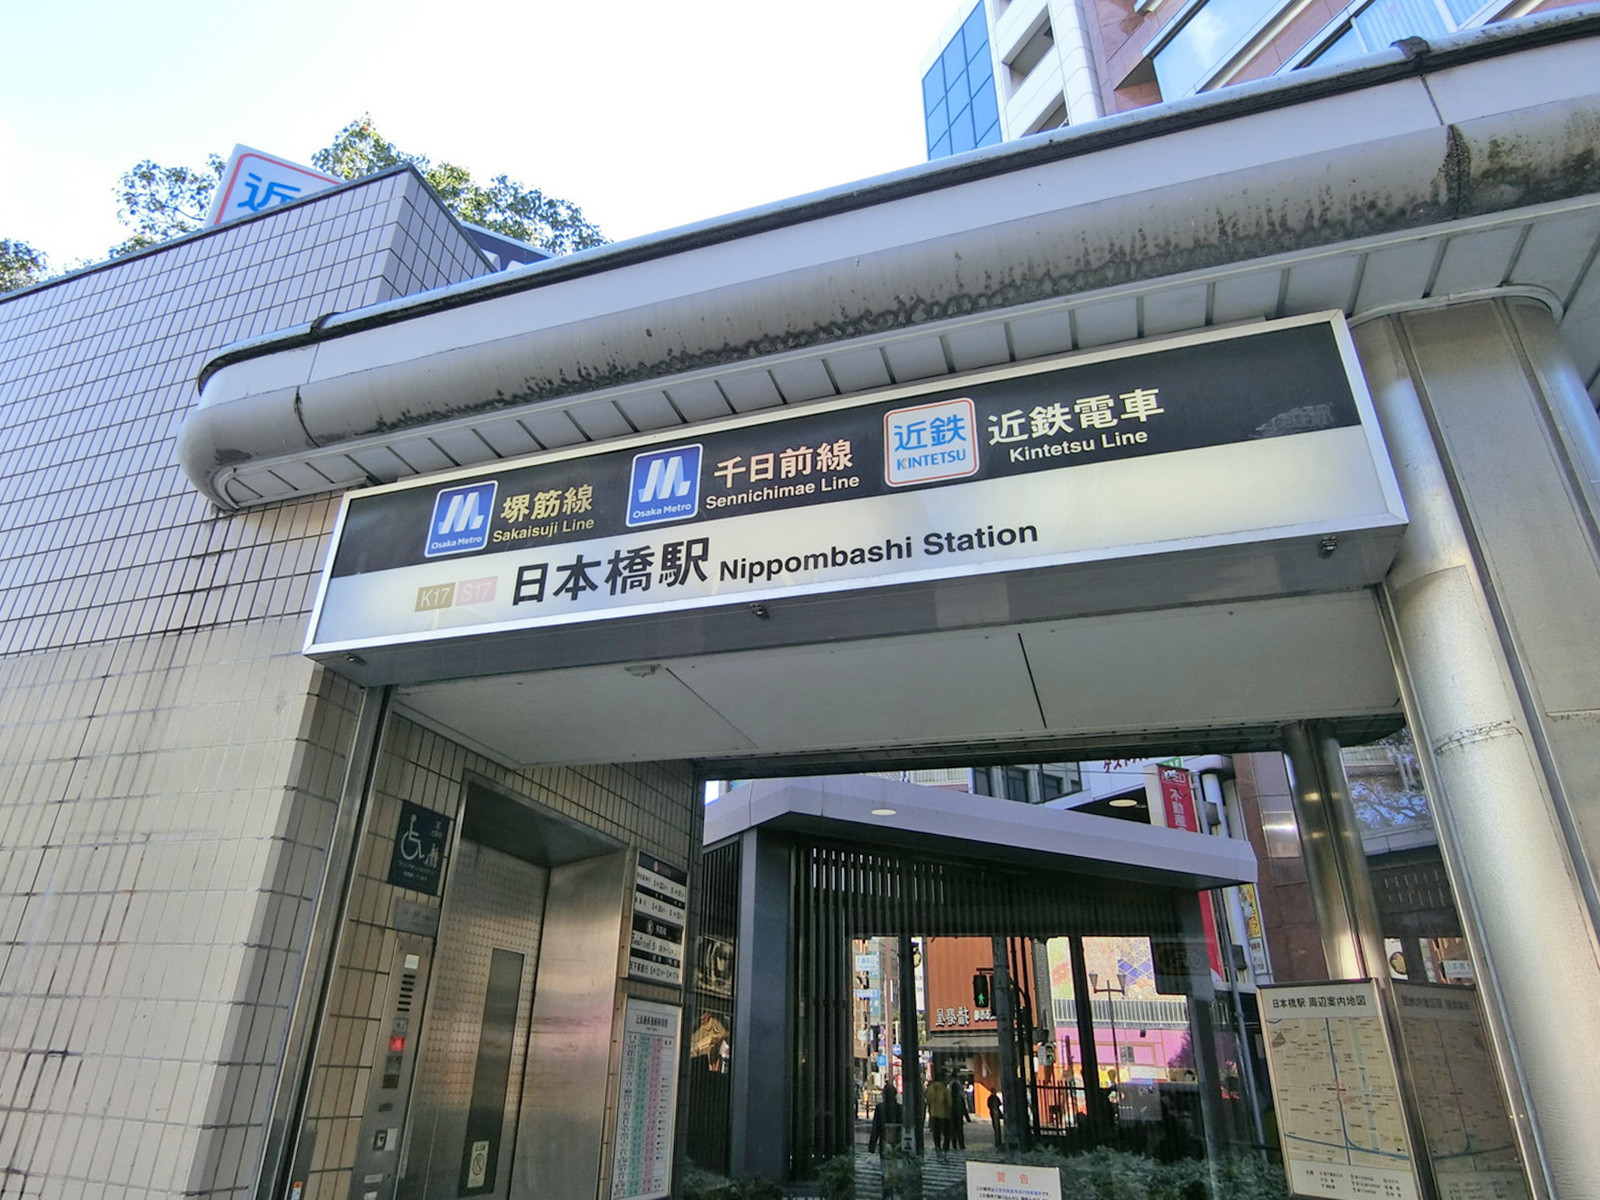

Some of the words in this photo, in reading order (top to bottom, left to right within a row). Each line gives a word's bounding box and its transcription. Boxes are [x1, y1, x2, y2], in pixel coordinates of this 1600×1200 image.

[893, 413, 968, 452] 近鉄
[988, 388, 1165, 446] 近鉄電車
[896, 448, 967, 471] KINTETSU
[1009, 437, 1096, 463] Kintetsu
[1102, 428, 1149, 450] Line
[714, 439, 853, 489] 千日前線
[500, 484, 594, 524] 堺筋線
[705, 482, 816, 510] Sennichimae
[821, 474, 860, 492] Line
[632, 508, 662, 519] Osaka
[664, 502, 692, 515] Metro
[431, 541, 457, 550] Osaka
[457, 536, 483, 546] Metro
[492, 521, 559, 544] Sakaisuji
[563, 516, 595, 533] Line
[512, 536, 710, 606] 日本橋駅
[719, 535, 913, 584] Nippombashi
[923, 524, 1038, 556] Station
[420, 587, 451, 608] K17
[462, 581, 492, 602] S17
[1272, 997, 1306, 1009] 日本橋駅
